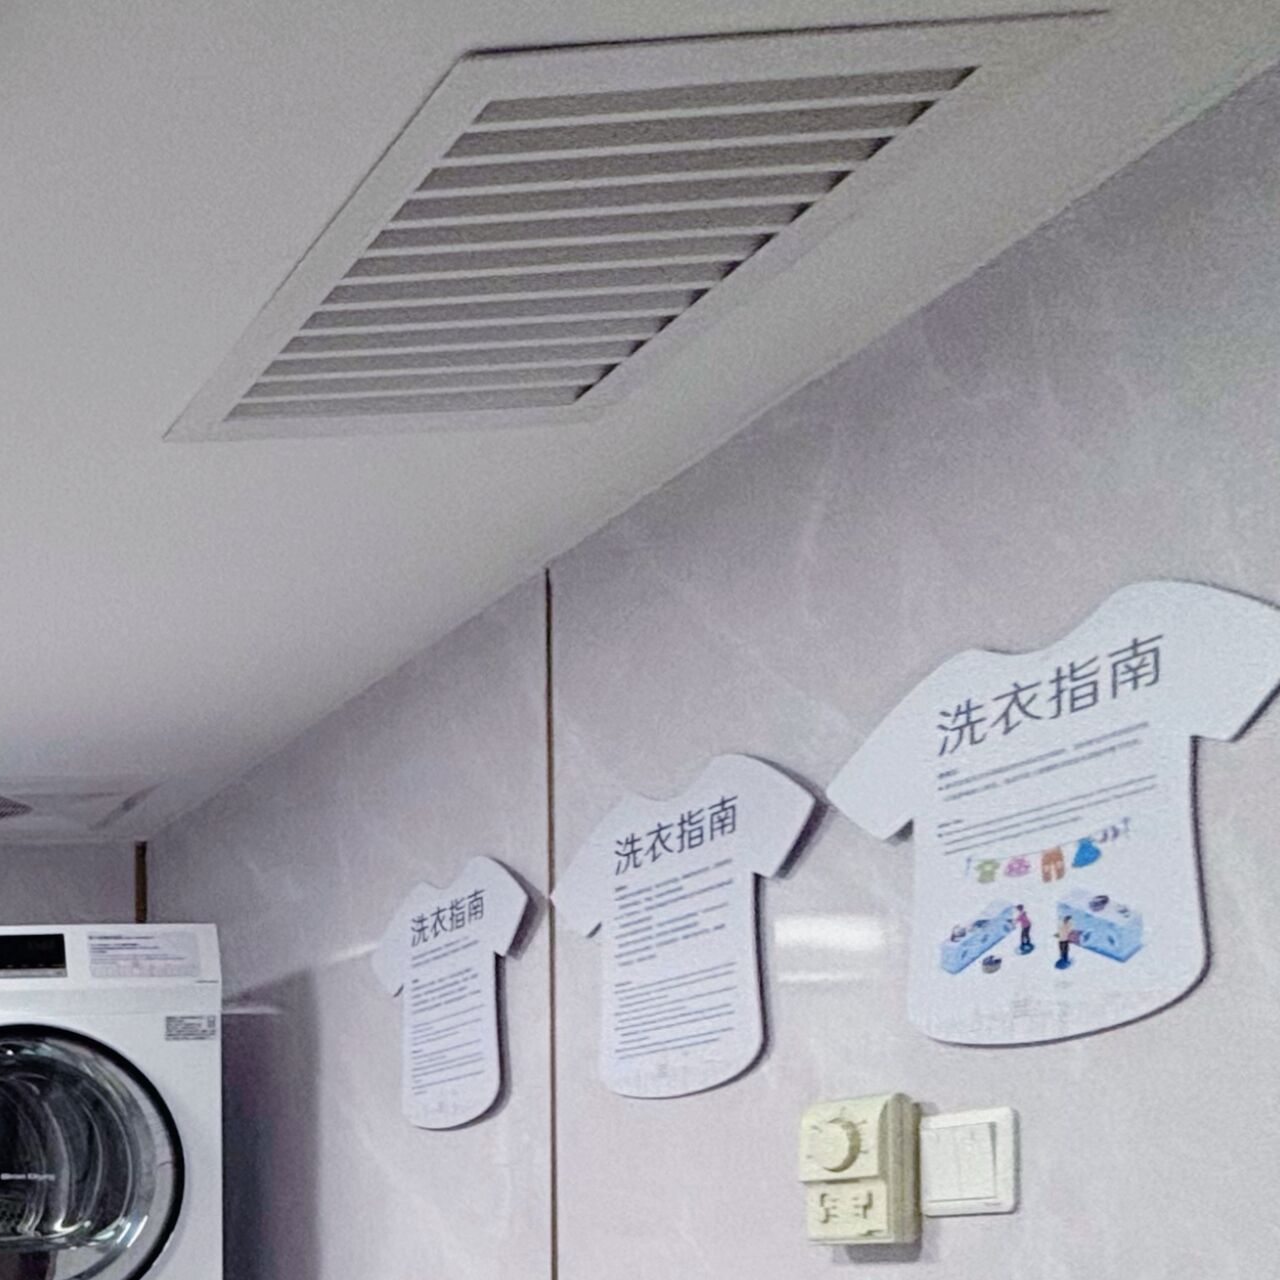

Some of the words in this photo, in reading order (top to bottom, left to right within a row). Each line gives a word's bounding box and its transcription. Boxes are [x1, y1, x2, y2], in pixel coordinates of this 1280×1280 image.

[937, 634, 1164, 756] 洗衣指南
[614, 796, 738, 875] 洗衣指南
[411, 889, 485, 946] 洗衣指南
